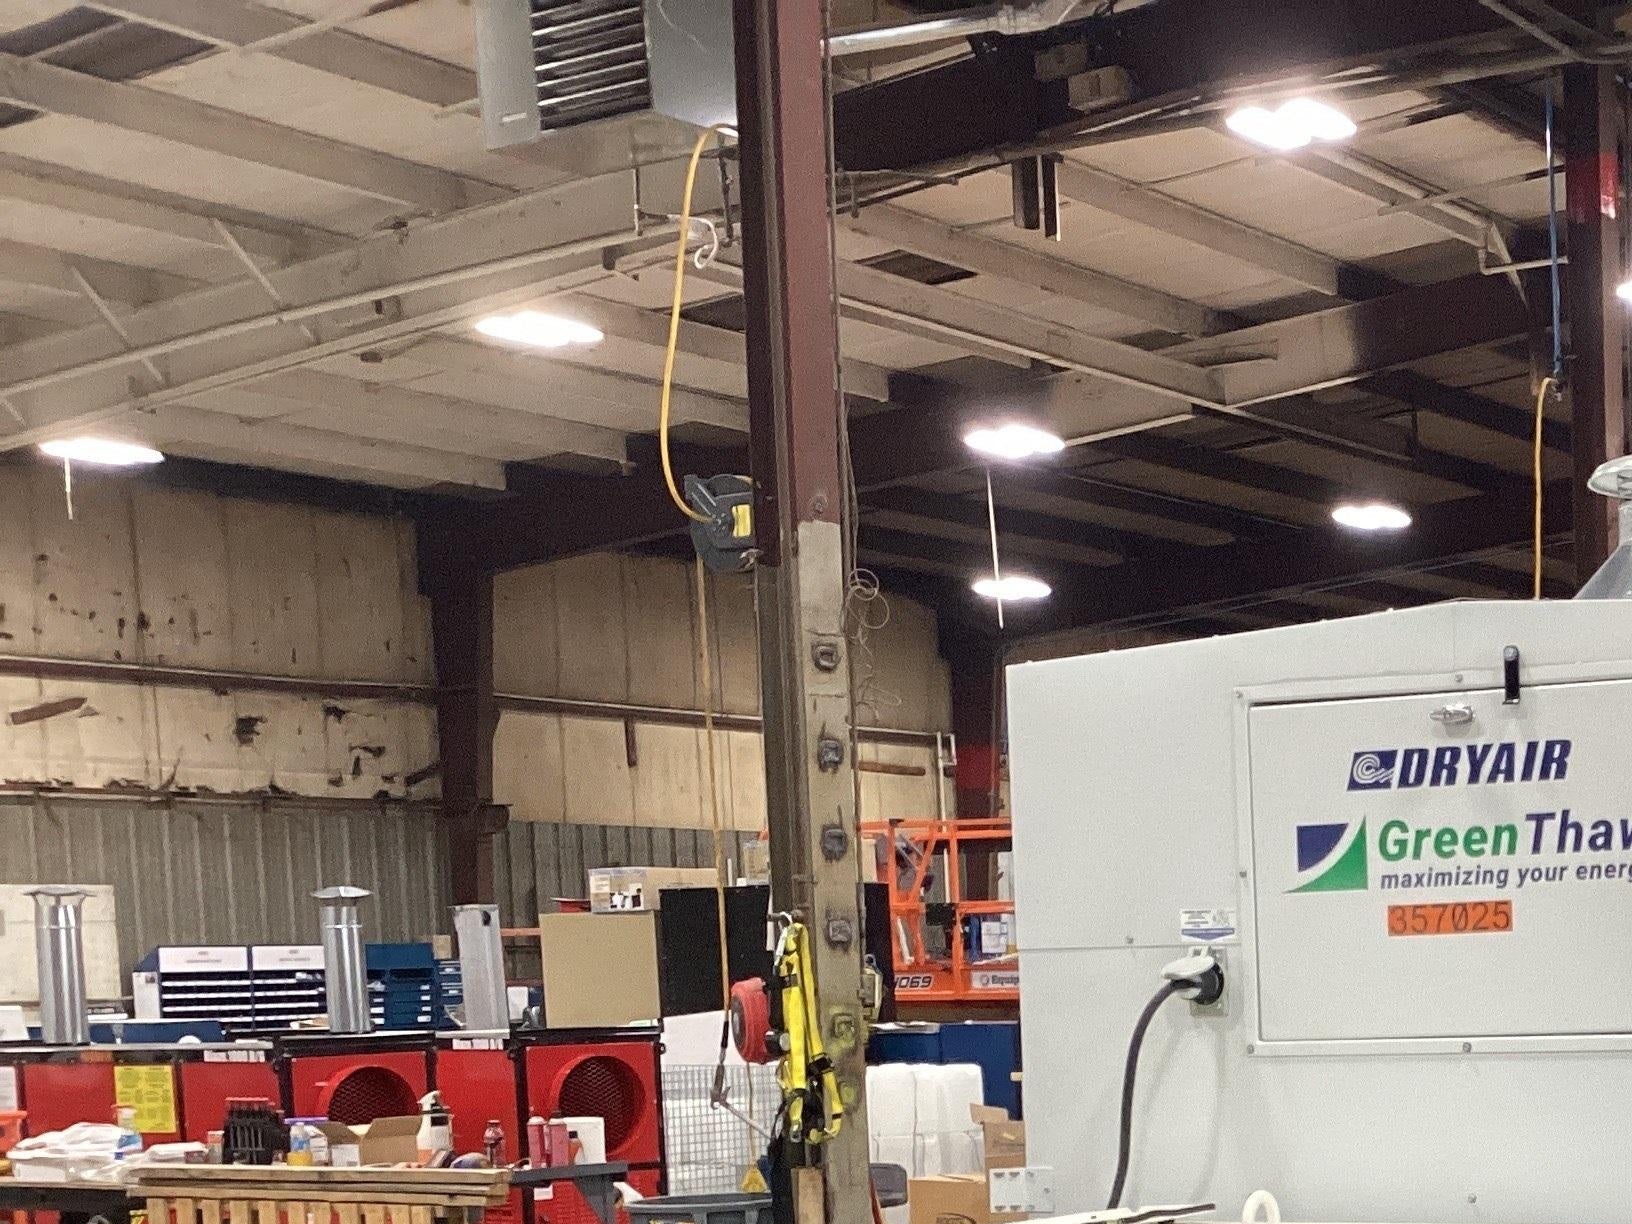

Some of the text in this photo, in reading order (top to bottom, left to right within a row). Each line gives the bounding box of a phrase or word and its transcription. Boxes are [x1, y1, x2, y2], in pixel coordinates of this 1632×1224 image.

[1398, 739, 1573, 789] DRYAIR
[1380, 865, 1509, 890] maximizing
[1516, 864, 1568, 889] your
[1388, 902, 1512, 934] 357025
